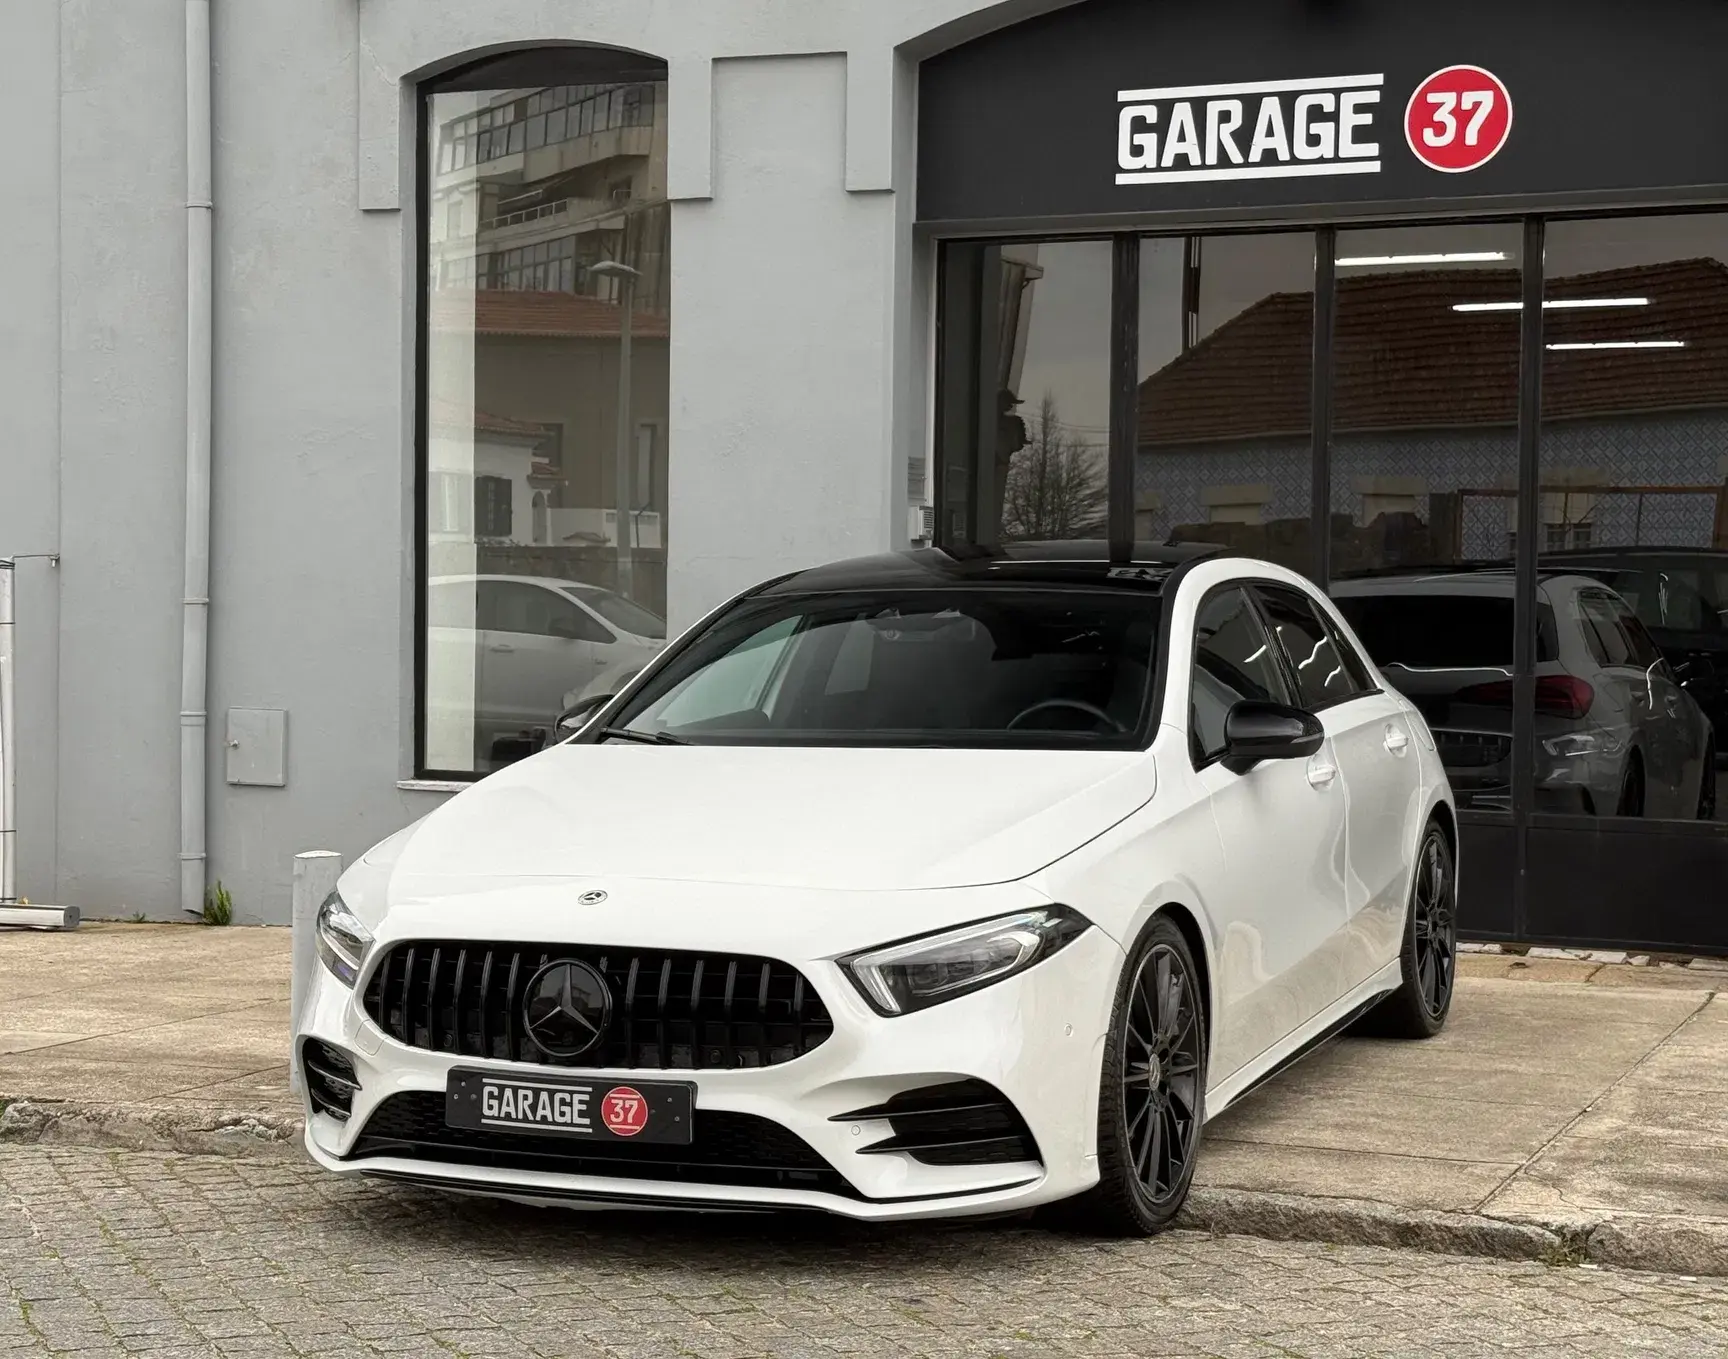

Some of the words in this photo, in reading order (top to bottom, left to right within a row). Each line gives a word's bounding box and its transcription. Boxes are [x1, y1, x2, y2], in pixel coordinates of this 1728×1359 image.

[1117, 89, 1381, 170] GARAGE
[1422, 90, 1495, 147] 37
[482, 1085, 591, 1125] GARAGE
[610, 1098, 639, 1124] 37
